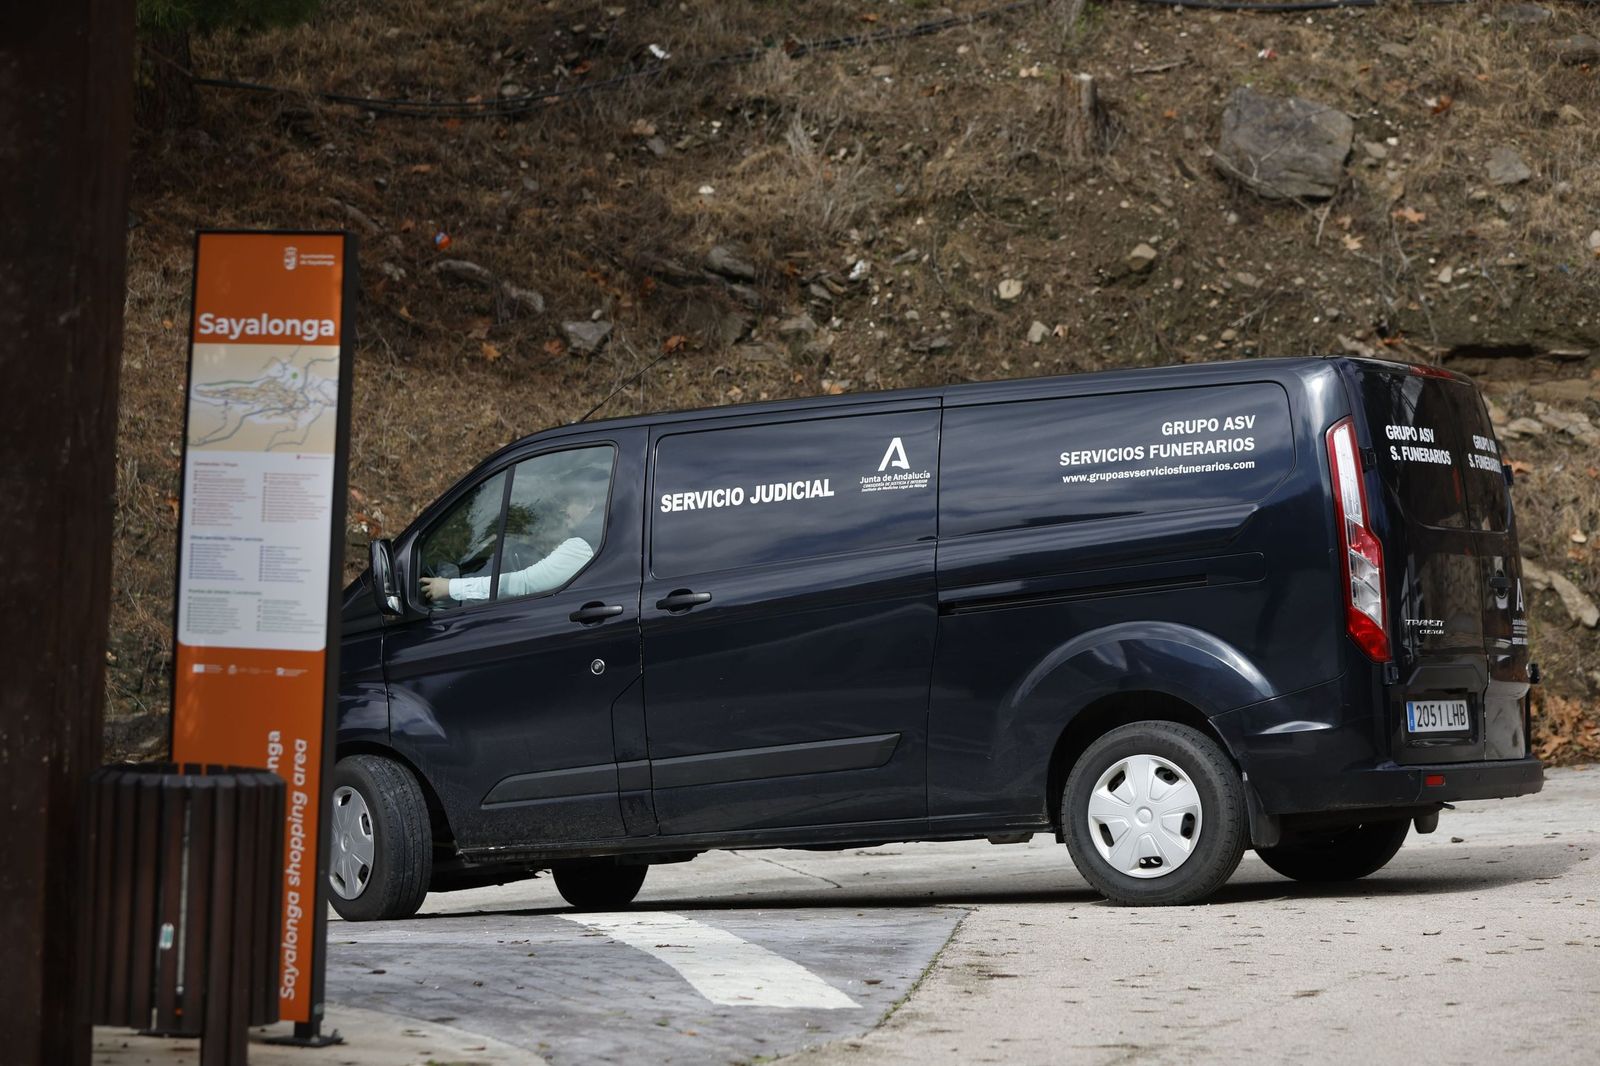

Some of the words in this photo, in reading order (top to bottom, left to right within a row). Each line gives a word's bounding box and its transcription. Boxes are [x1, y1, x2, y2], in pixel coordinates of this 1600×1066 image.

[199, 312, 336, 342] Sayalonga
[1161, 417, 1220, 436] GRUPO
[1223, 415, 1257, 431] ASV
[1385, 424, 1419, 442] GRUPO
[1418, 427, 1436, 443] ASV
[1059, 446, 1145, 466] SERVICIOS
[1149, 437, 1256, 459] FUNERARIOS
[1389, 445, 1401, 461] S.
[1401, 446, 1452, 466] FUNERARIOS
[859, 476, 881, 484] Junta
[882, 473, 892, 482] de
[893, 470, 931, 481] Andalucía
[1062, 461, 1256, 484] www.grupoasvserviciosfunerarios.com
[660, 487, 745, 513] SERVICIO
[749, 478, 835, 504] JUDICIAL
[1416, 704, 1443, 728] 2051
[1445, 703, 1467, 727] LHB
[292, 738, 308, 786] area
[285, 790, 308, 886] shopping
[280, 891, 303, 1000] Sayalonga
